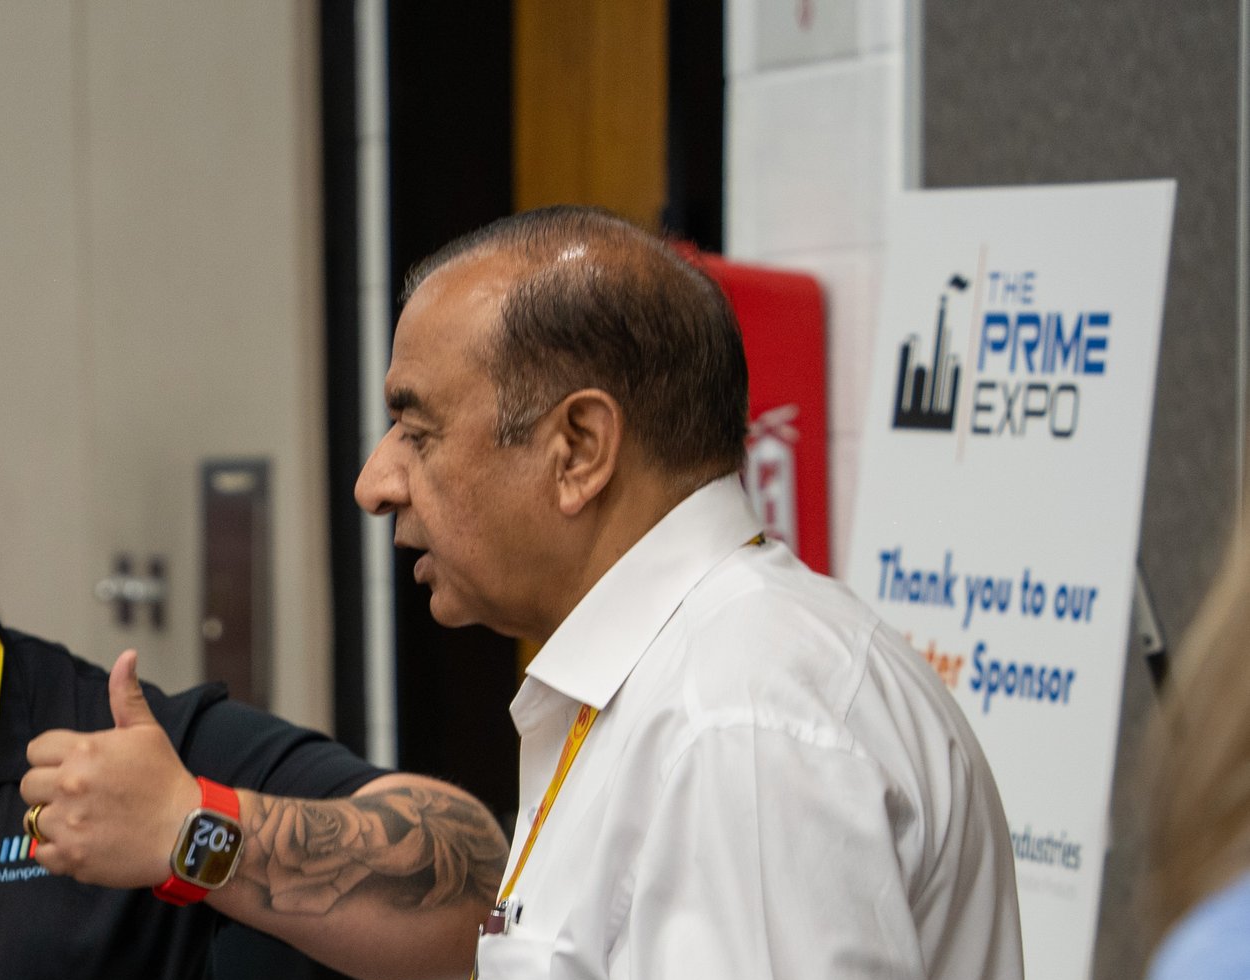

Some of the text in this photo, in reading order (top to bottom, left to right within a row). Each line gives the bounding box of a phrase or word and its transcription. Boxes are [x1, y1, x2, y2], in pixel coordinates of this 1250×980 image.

[988, 271, 1037, 305] THE
[977, 312, 1112, 375] PRIME
[971, 381, 1080, 438] EXPO
[879, 546, 1098, 629] Thank you to our
[969, 641, 1077, 715] Sponsor
